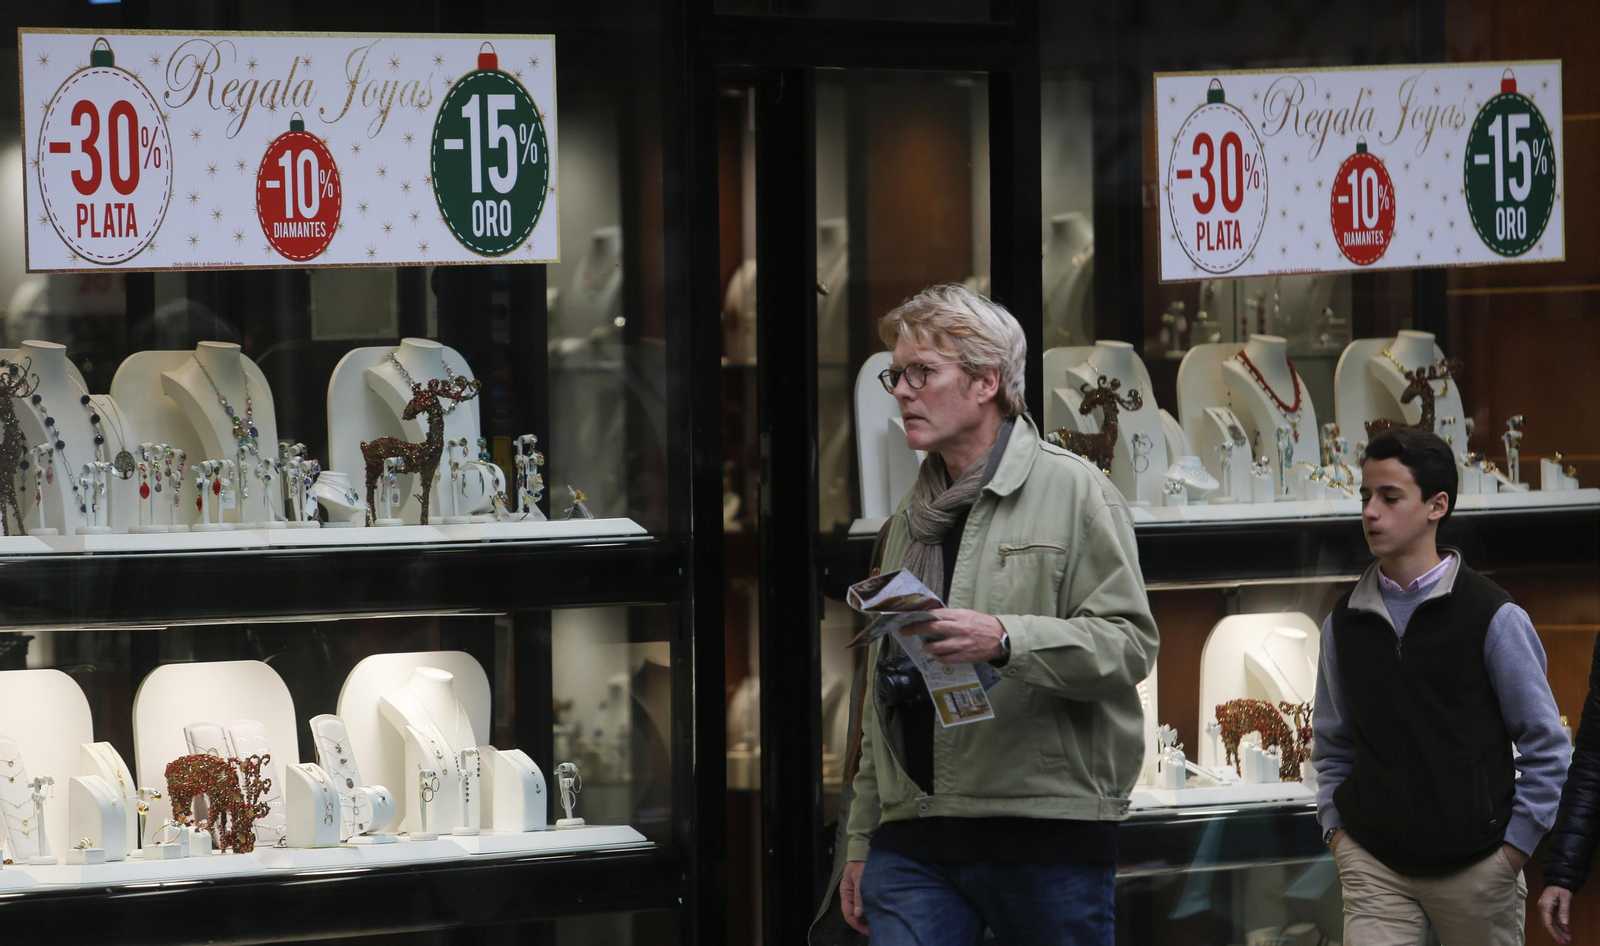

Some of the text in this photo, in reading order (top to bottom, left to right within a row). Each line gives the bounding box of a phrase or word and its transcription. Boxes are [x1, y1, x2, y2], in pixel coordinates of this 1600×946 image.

[164, 38, 433, 139] Regala Joyas
[1262, 69, 1467, 161] Regala Joyas
[49, 99, 161, 196] -30%
[443, 93, 538, 194] -15%
[1176, 131, 1260, 215] -30%
[1474, 113, 1547, 202] -15%
[265, 148, 334, 219] -10%
[1338, 167, 1390, 229] -10%
[76, 202, 138, 239] PLATA
[273, 221, 326, 239] DIAMANTES
[472, 199, 512, 237] ORO
[1197, 219, 1242, 251] PLATA
[1343, 229, 1384, 246] DIAMANTES
[1496, 206, 1527, 240] ORO
